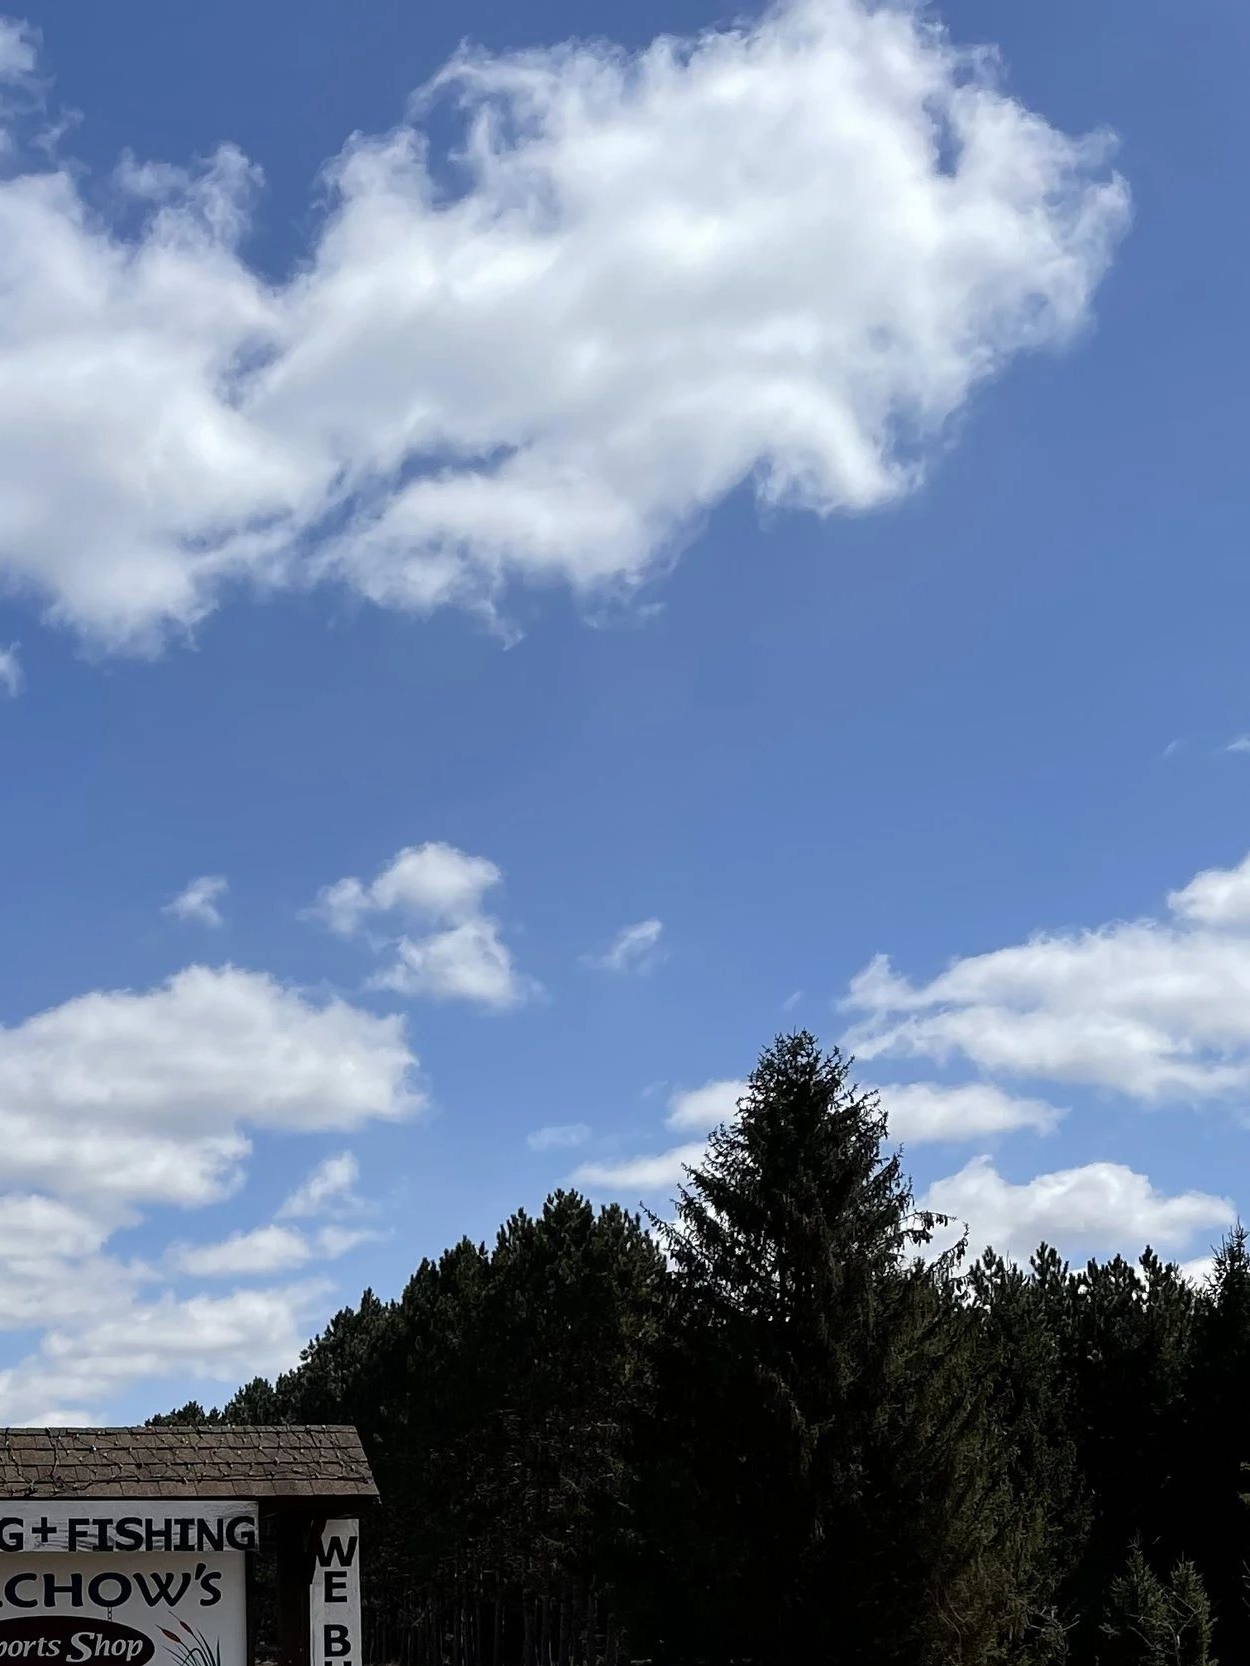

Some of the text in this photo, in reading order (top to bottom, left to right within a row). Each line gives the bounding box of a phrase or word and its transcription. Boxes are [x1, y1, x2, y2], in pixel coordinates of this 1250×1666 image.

[67, 1515, 257, 1553] FISHING
[316, 1536, 358, 1603] WE
[65, 1632, 144, 1664] Shop
